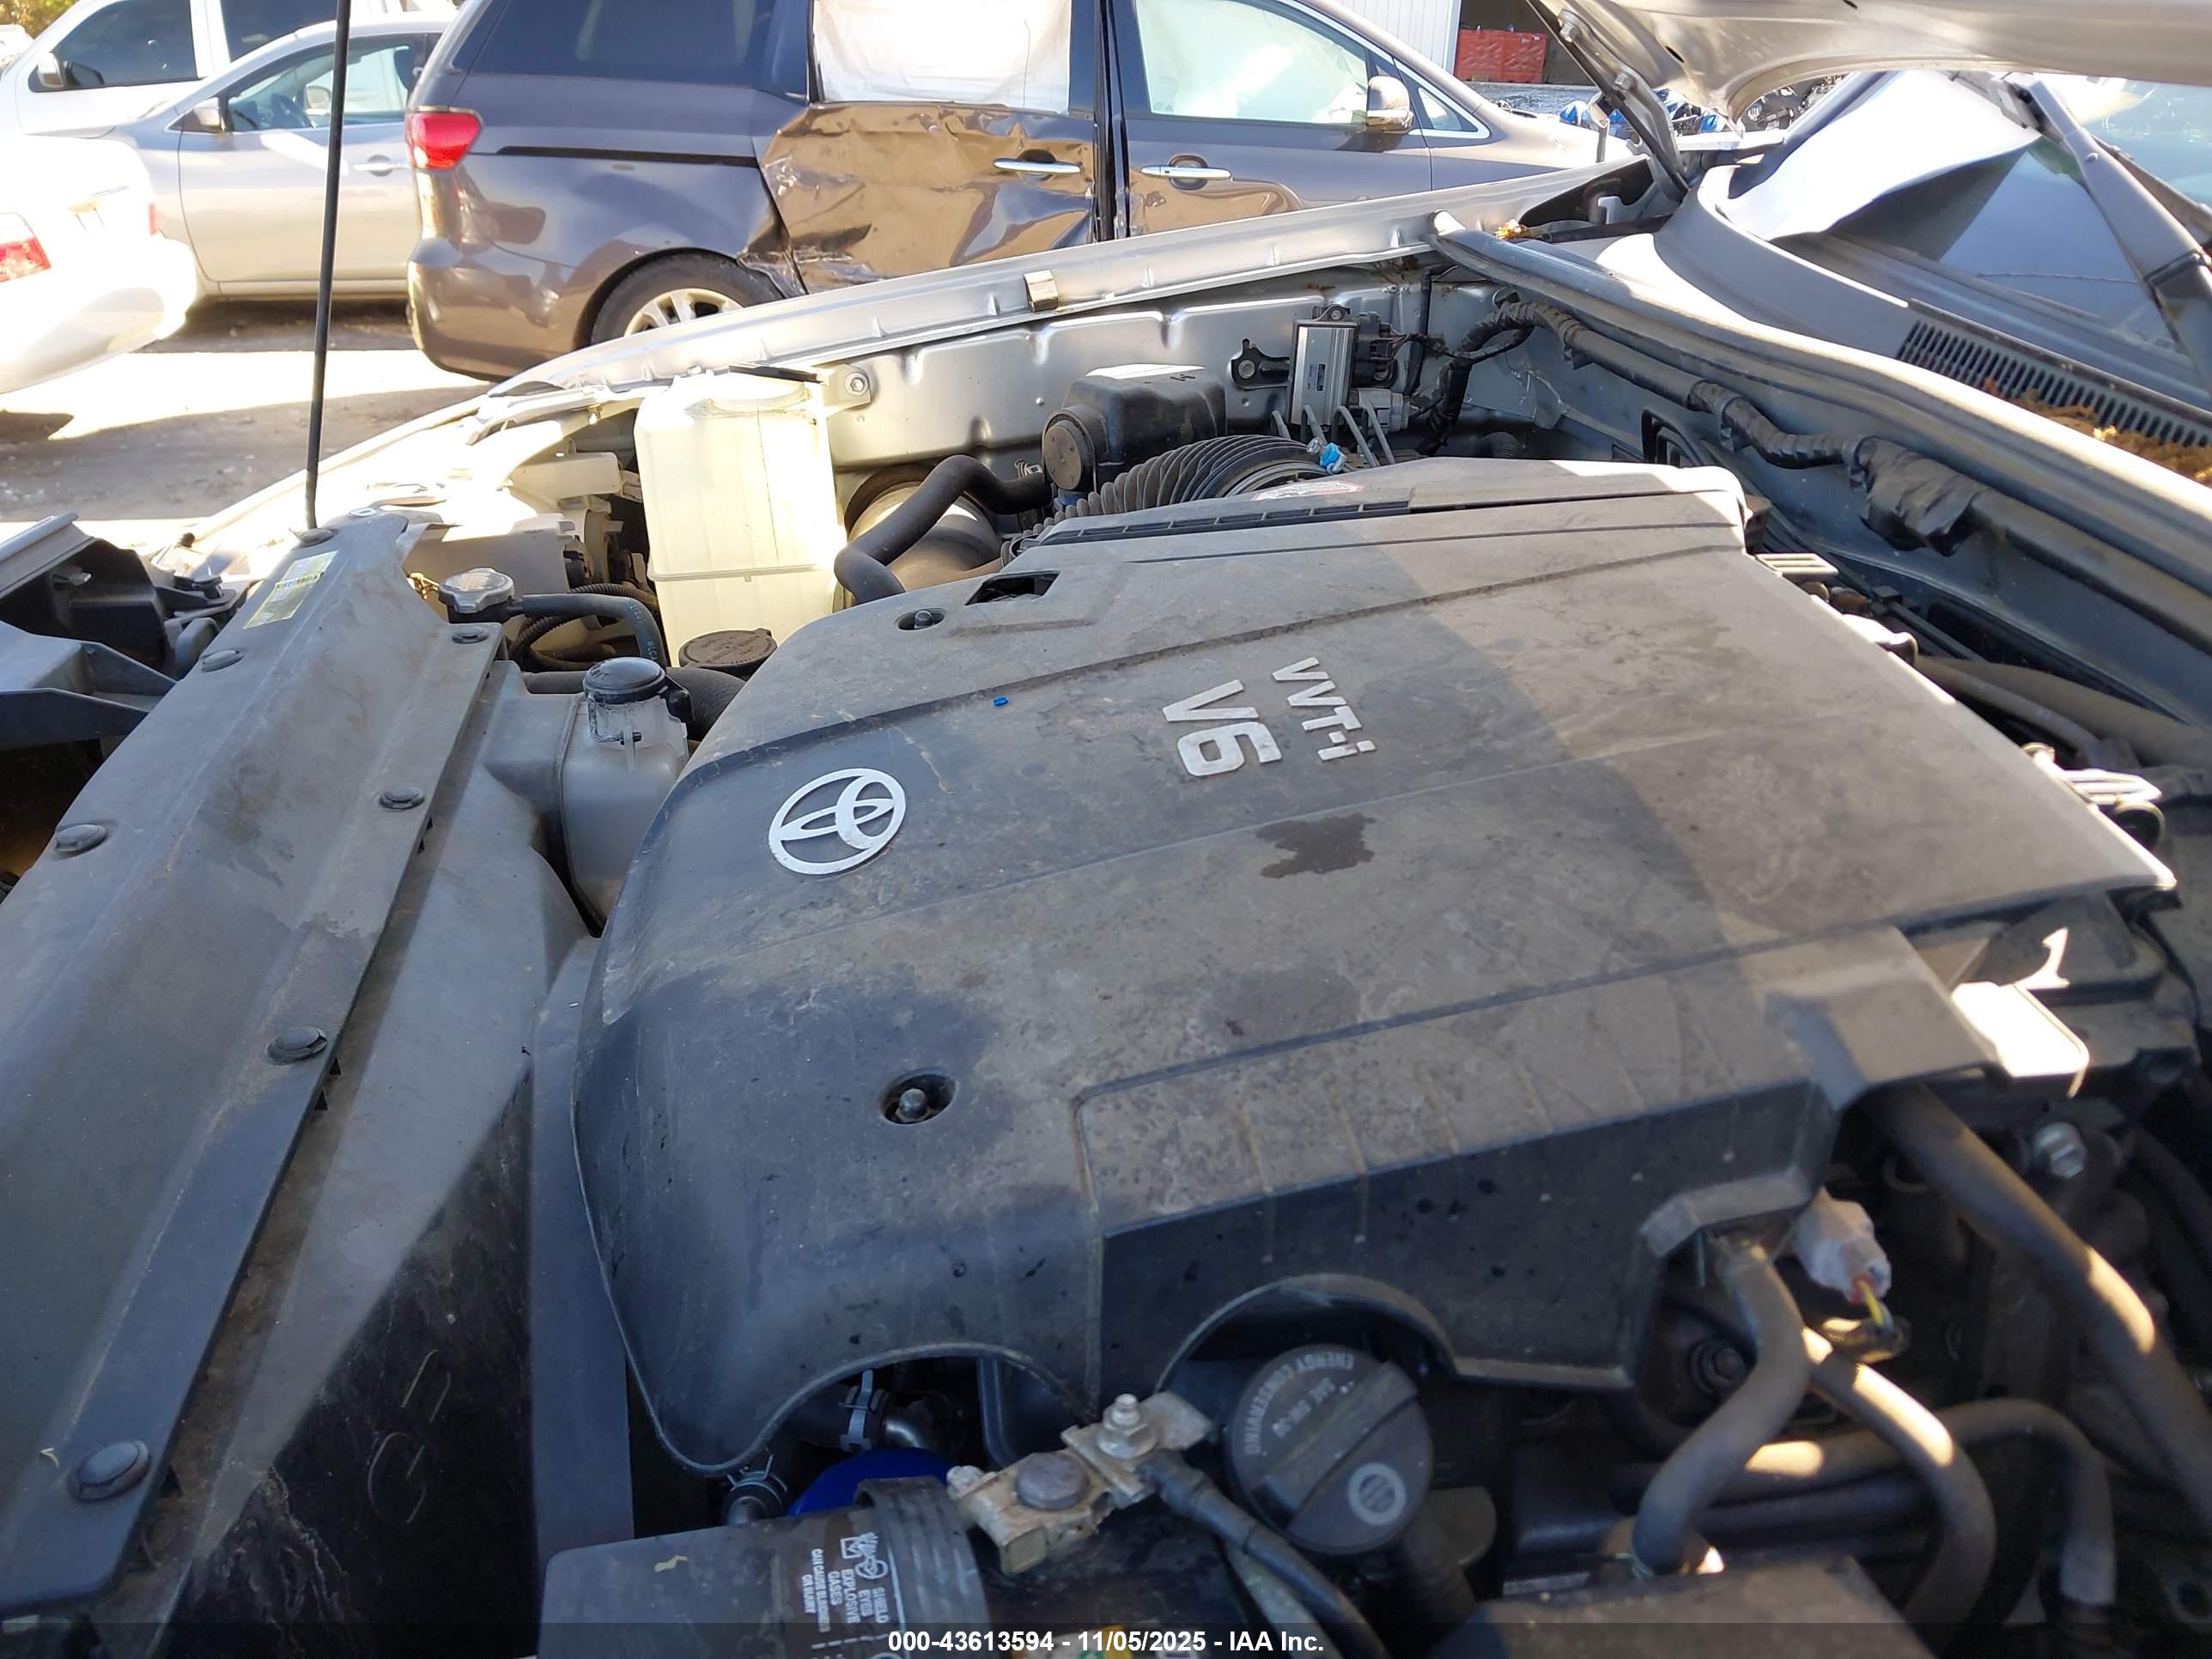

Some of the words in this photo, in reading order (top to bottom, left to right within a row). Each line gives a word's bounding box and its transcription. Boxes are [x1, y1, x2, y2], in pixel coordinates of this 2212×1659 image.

[1272, 657, 1376, 761] VVT-i
[1162, 679, 1284, 777] V6
[1296, 1352, 1354, 1374] ENERGY
[1243, 1364, 1294, 1455] CONSERVING
[811, 1548, 824, 1565] CAN
[802, 1574, 813, 1586] OR
[813, 1565, 827, 1591] CAUSE
[828, 1571, 842, 1606] GASES
[804, 1586, 817, 1613] INJURY
[816, 1590, 830, 1632] BLINDNESS
[842, 1569, 861, 1623] EXPLOSIVE
[858, 1589, 873, 1617] EYES
[872, 1587, 889, 1623] SHIELD
